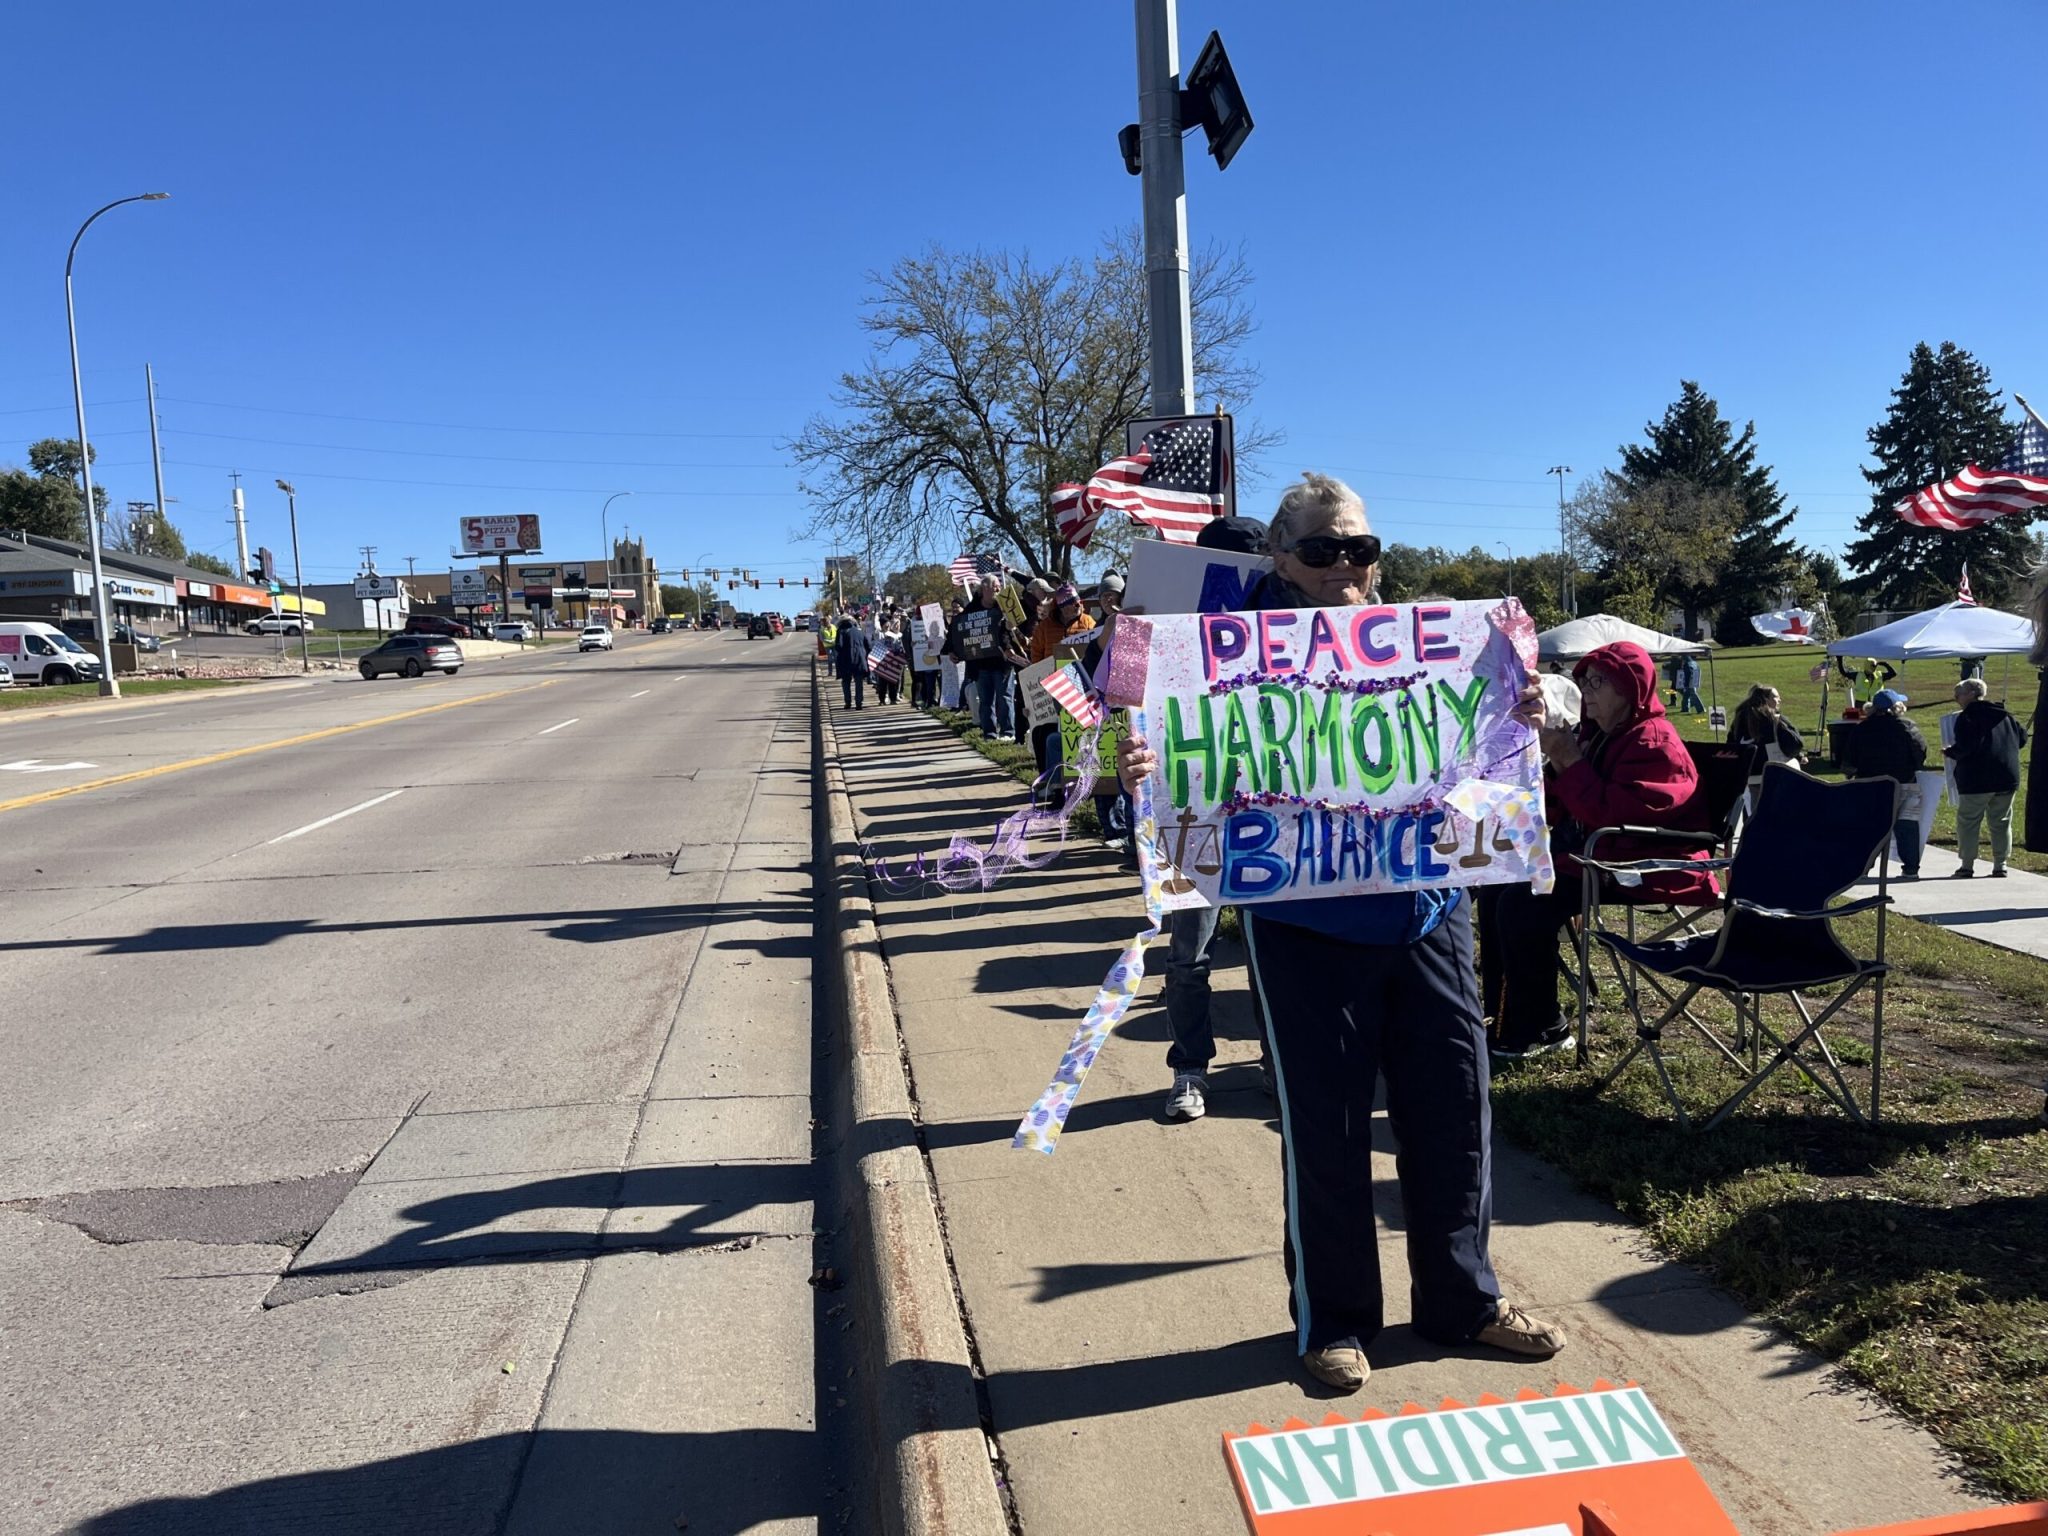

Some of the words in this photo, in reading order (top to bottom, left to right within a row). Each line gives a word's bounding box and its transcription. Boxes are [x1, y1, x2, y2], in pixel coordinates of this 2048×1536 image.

[484, 516, 516, 524] BAKED
[484, 526, 517, 534] PIZZAS
[967, 609, 989, 621] DISSENT
[1000, 588, 1021, 625] VOTE
[964, 620, 973, 630] THE
[973, 616, 992, 628] HIGHEST
[963, 633, 994, 647] PATRIOTISM
[1199, 605, 1461, 682] PEACE
[1164, 676, 1490, 809] HARMONY
[1219, 810, 1450, 898] BALANCE
[1235, 1390, 1679, 1510] MERIDIAN
